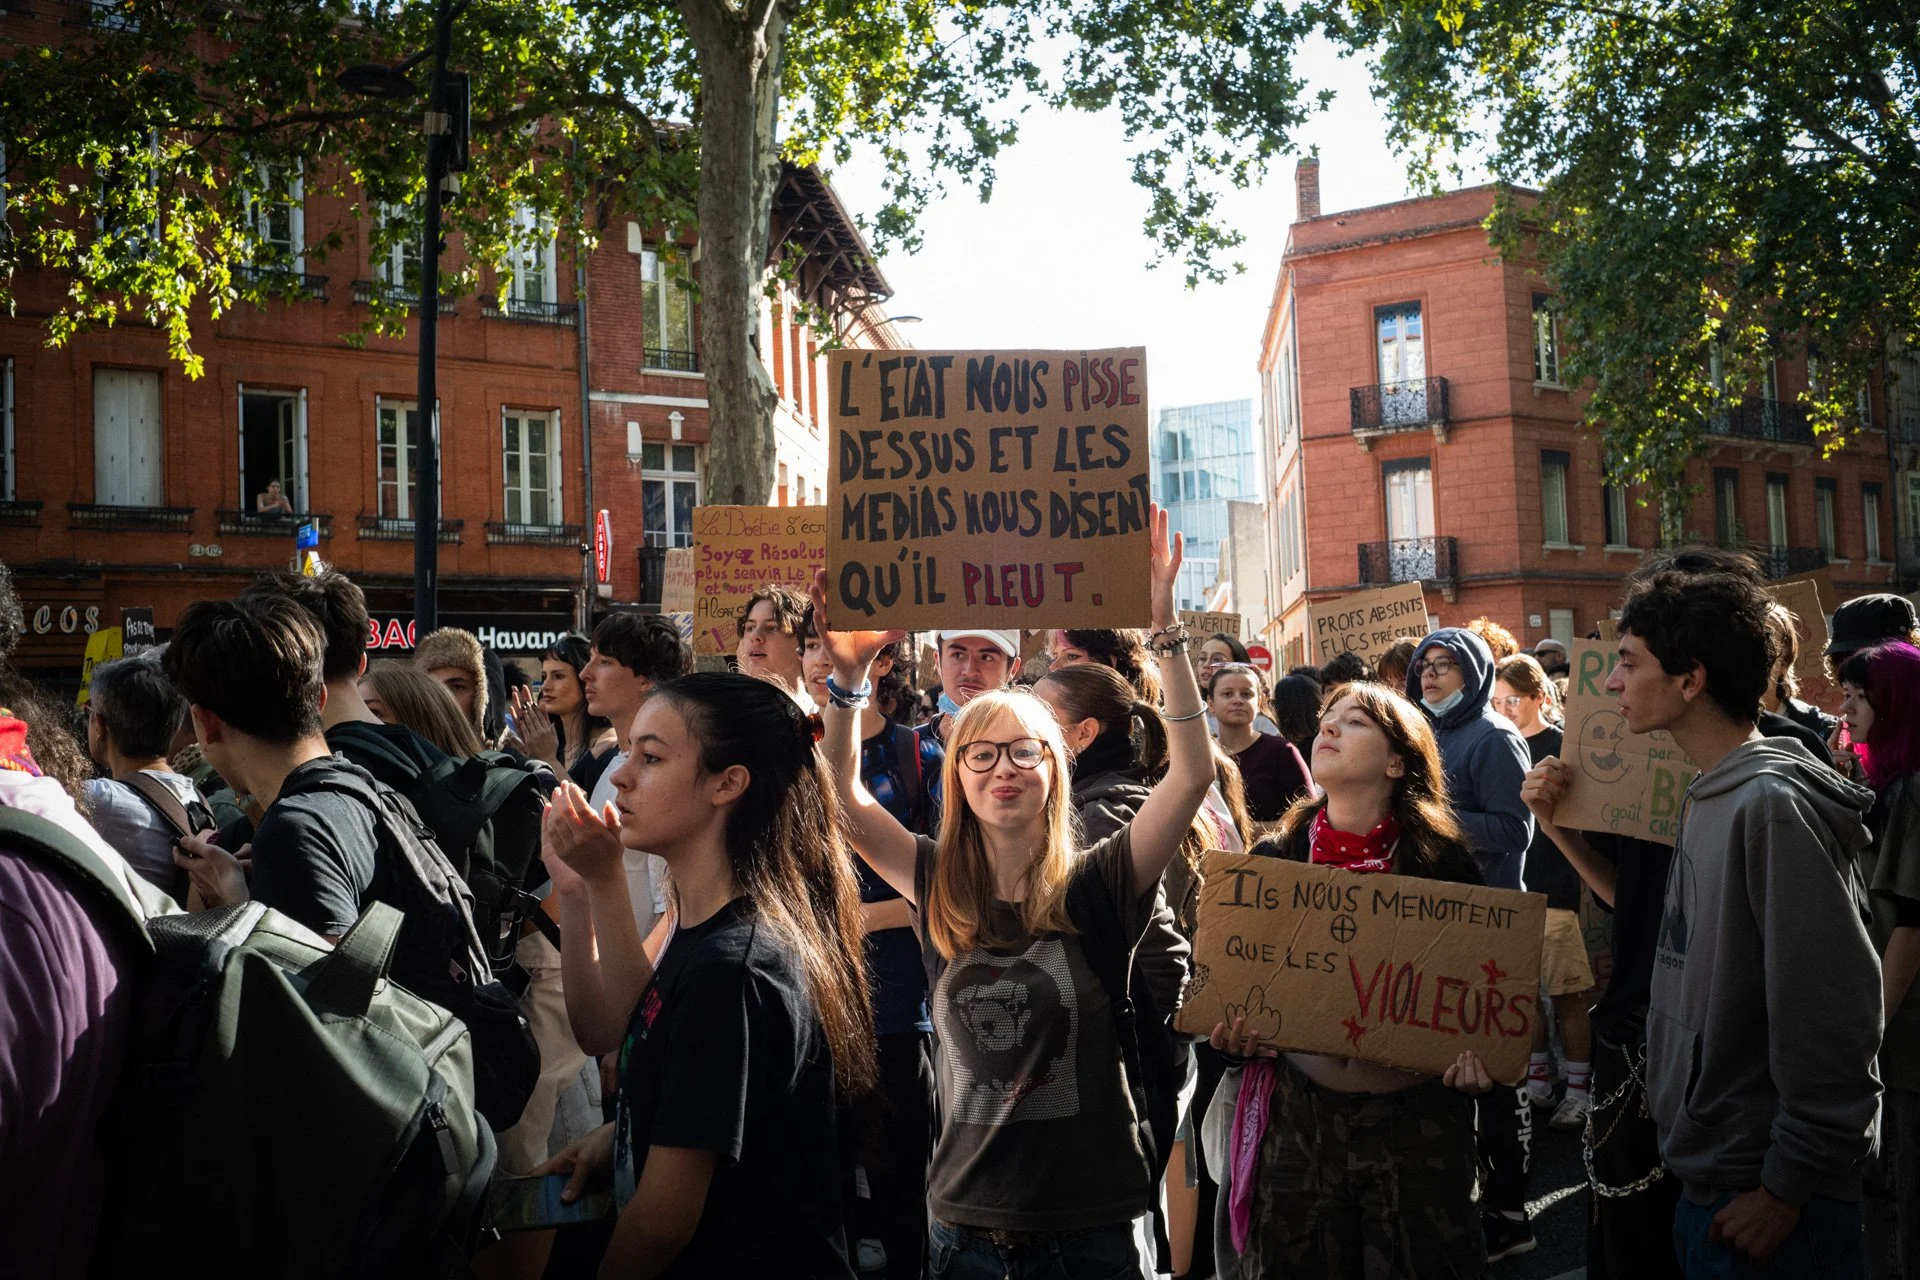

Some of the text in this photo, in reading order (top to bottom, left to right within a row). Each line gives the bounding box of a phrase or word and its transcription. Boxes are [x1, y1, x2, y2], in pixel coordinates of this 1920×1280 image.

[839, 352, 954, 422] L'ETAT
[966, 355, 1049, 414] NOUS
[840, 424, 1131, 484] DESSUS ET LES
[963, 489, 1042, 537] NOUS
[702, 545, 754, 566] Soyez
[695, 565, 727, 586] plus
[808, 564, 822, 580] T
[705, 582, 720, 595] et
[20, 605, 99, 634] COS
[1183, 615, 1196, 628] LA
[1317, 597, 1424, 635] PROFS ABSENTS
[366, 618, 415, 649] BA
[478, 626, 567, 650] Havan
[1187, 636, 1203, 650] ORT
[1293, 882, 1362, 913] NOUS
[1373, 889, 1519, 930] MENOTTENT
[1225, 935, 1533, 1038] QUE LES VIOLEURS
[1514, 1087, 1532, 1174] adida
